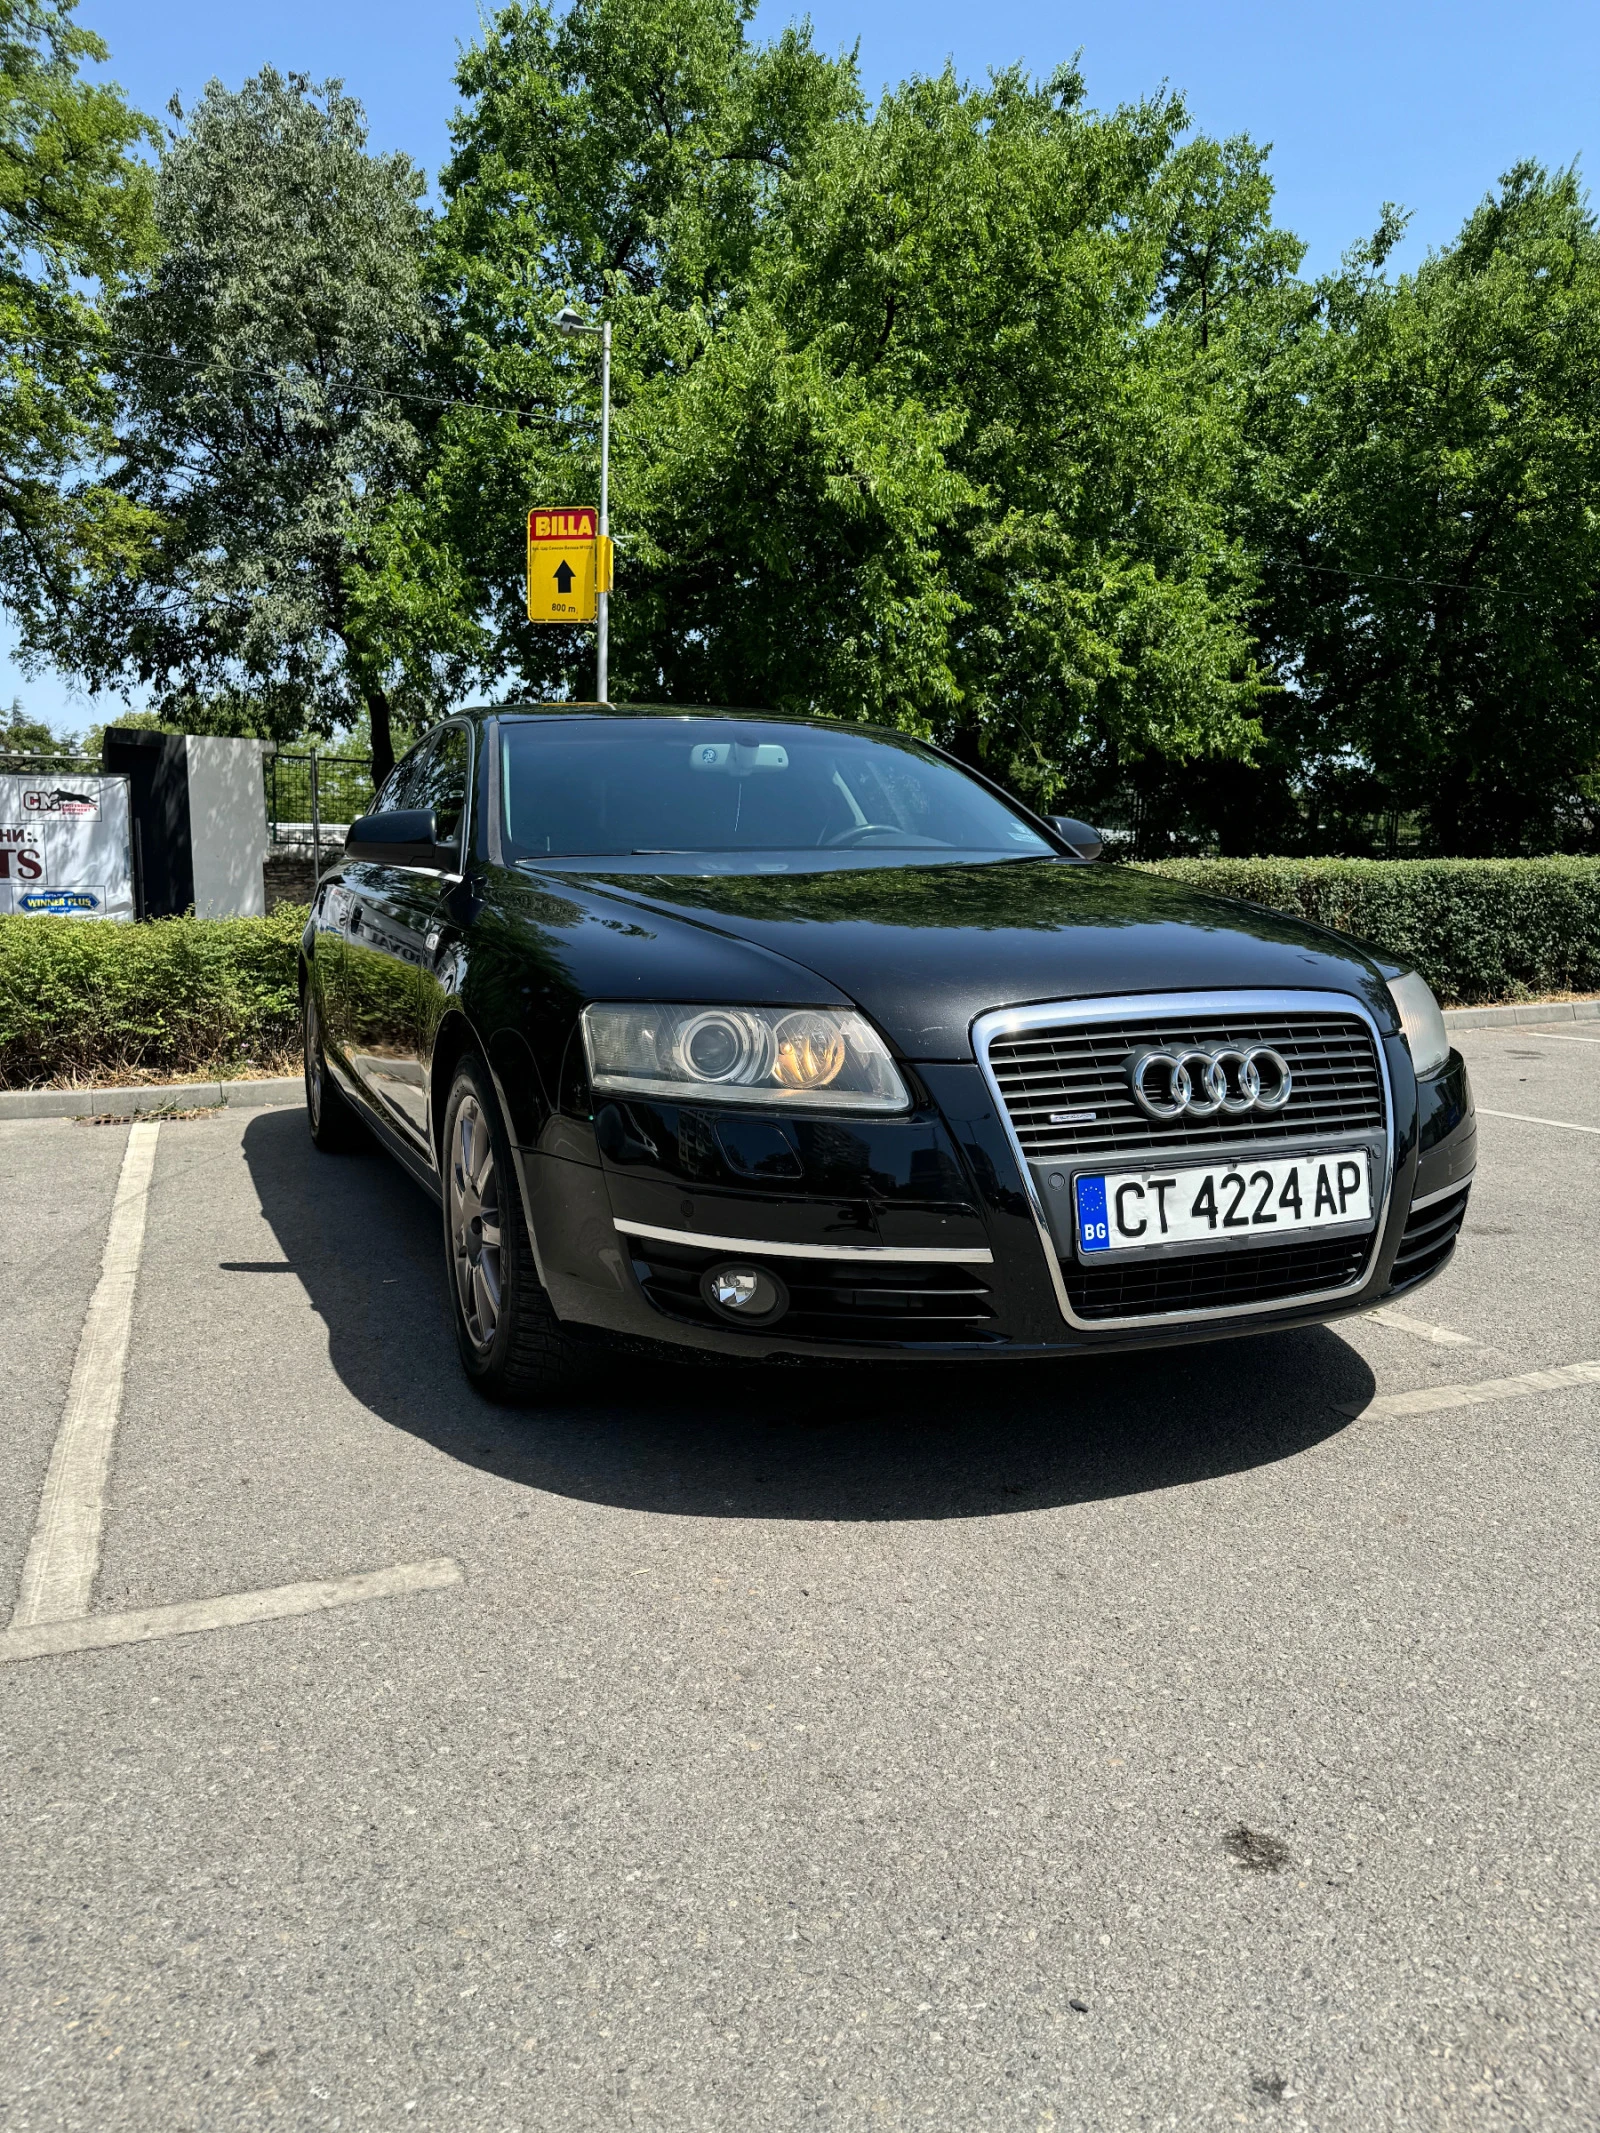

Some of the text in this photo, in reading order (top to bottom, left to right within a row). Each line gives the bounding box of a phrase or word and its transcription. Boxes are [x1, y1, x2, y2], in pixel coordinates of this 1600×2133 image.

[535, 515, 592, 536] BILLA
[552, 603, 566, 612] 800
[23, 791, 61, 811] CM
[27, 898, 91, 907] WINNER PLUS
[1115, 1160, 1361, 1238] CT 4224 AP
[1084, 1222, 1107, 1240] BG
